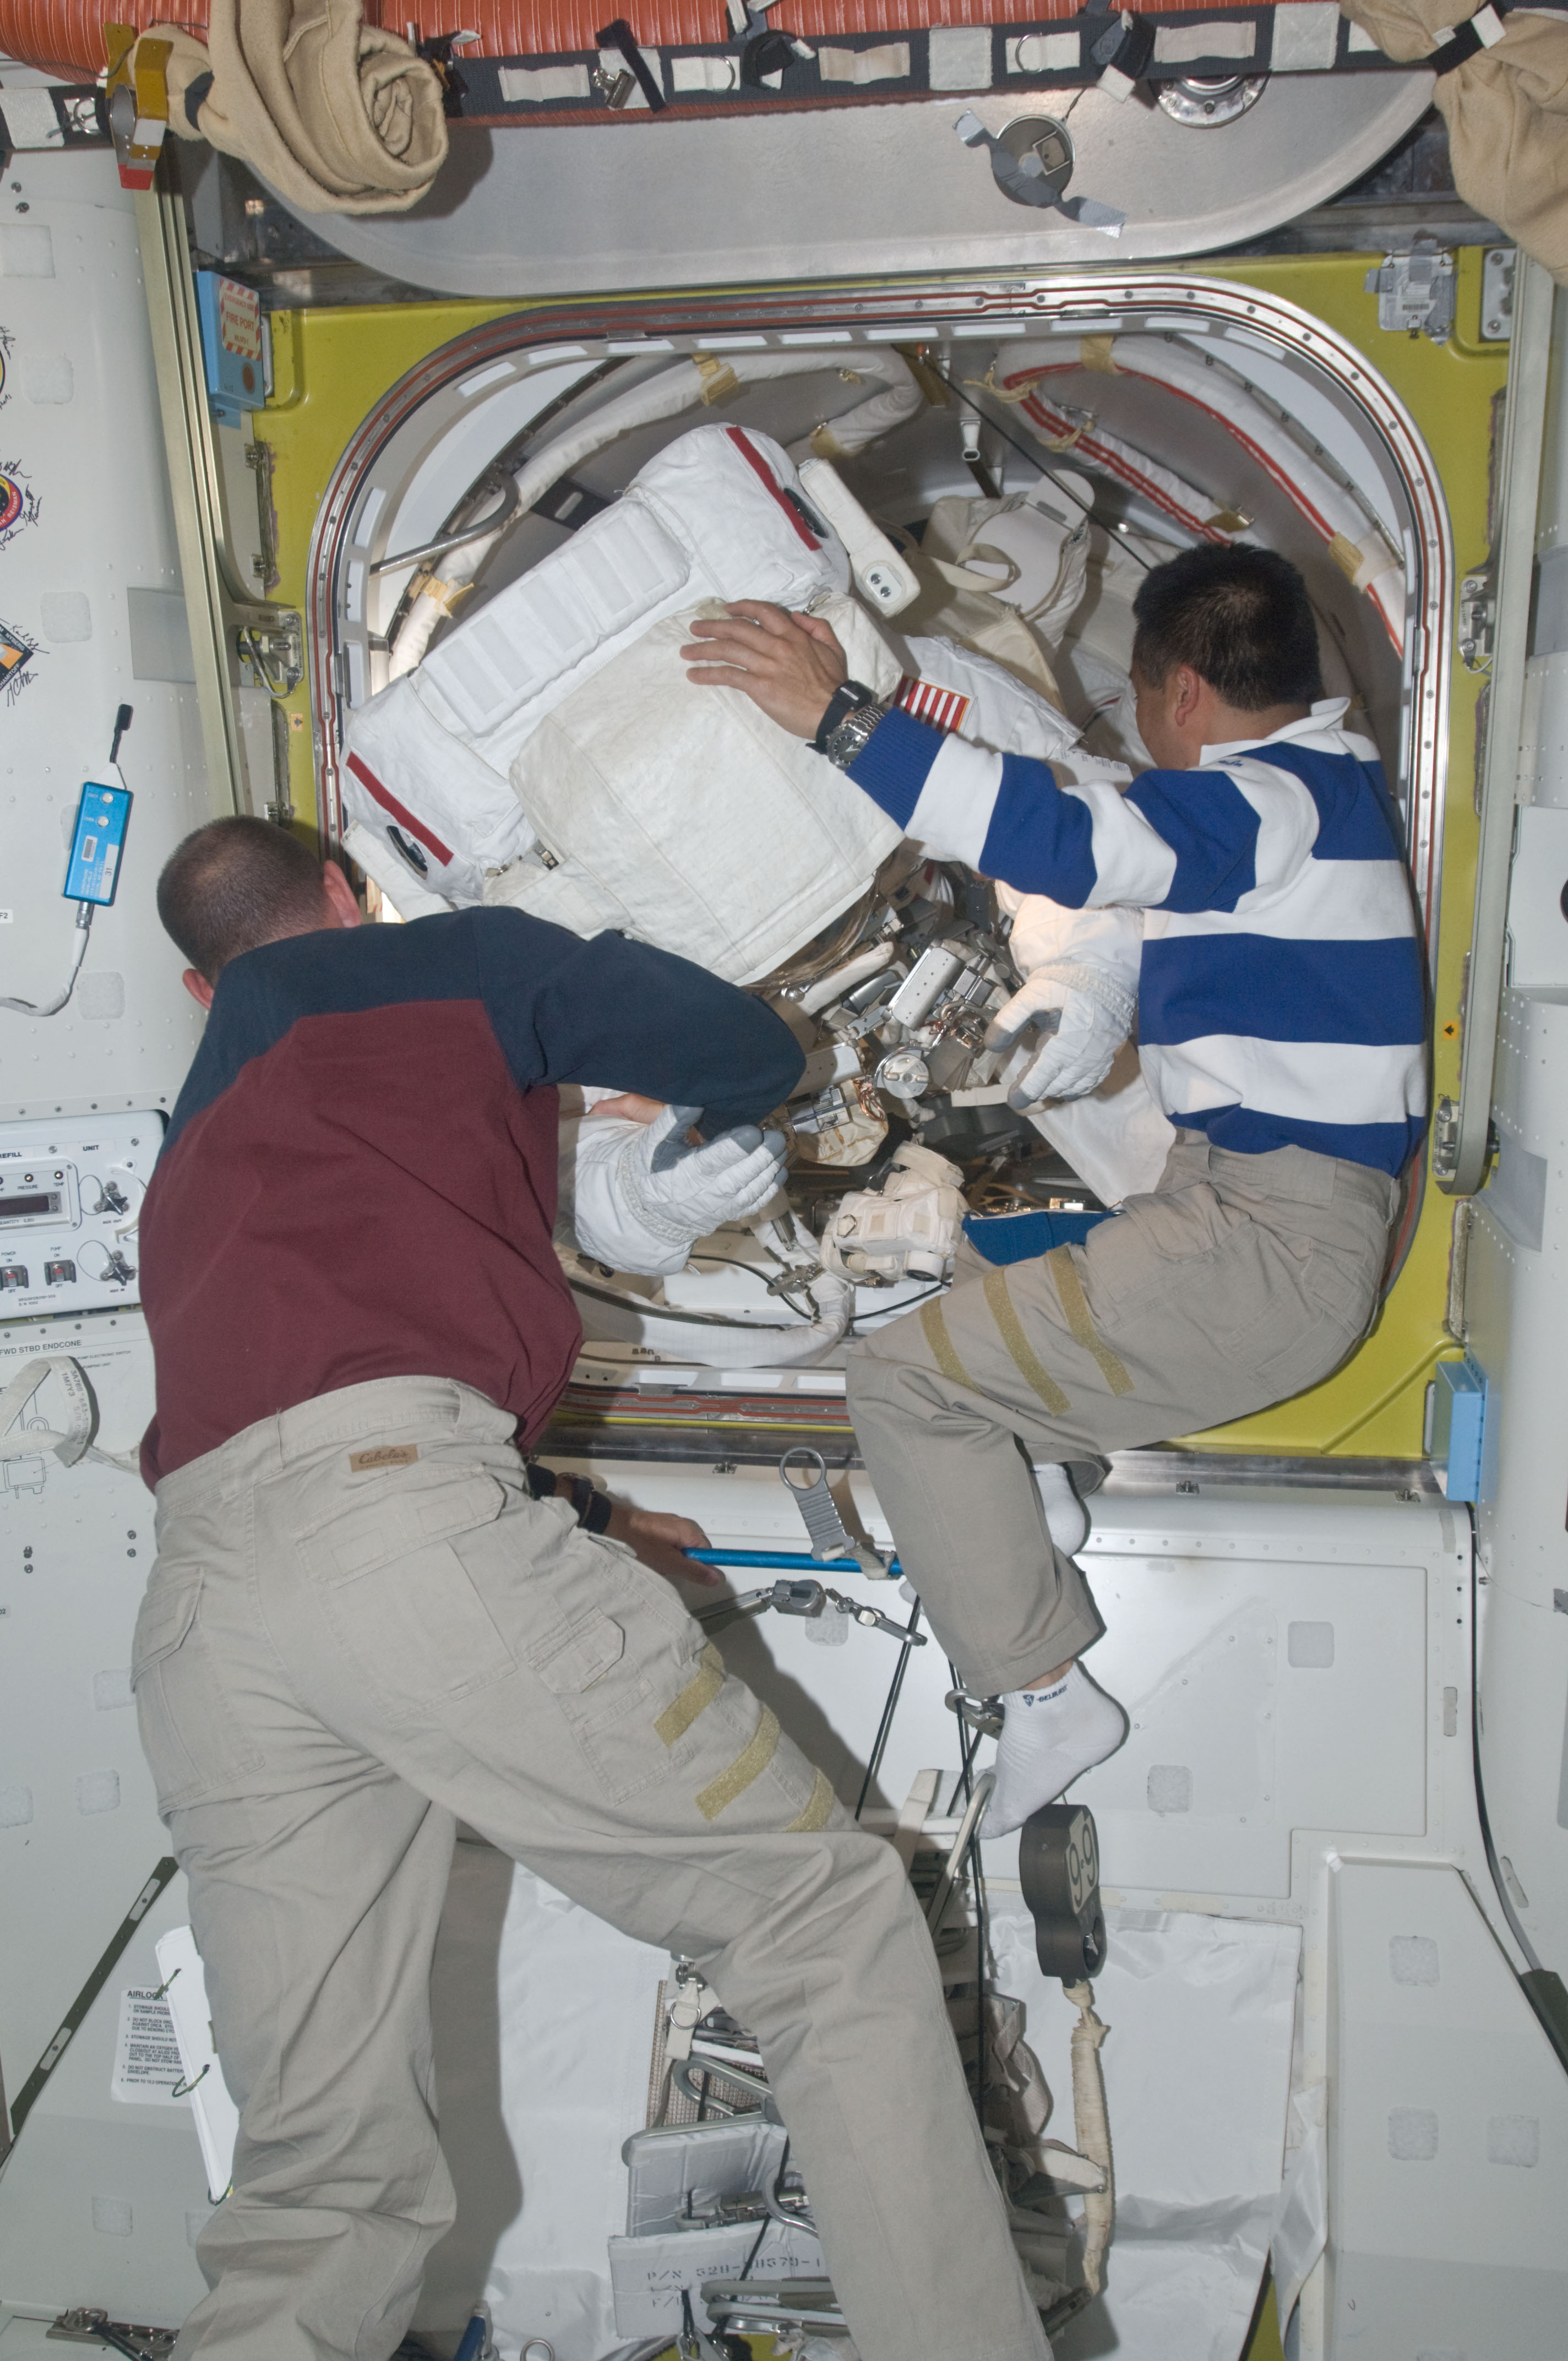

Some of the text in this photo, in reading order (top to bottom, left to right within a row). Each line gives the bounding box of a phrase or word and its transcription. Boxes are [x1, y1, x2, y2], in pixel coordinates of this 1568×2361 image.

[226, 311, 254, 331] FIRE PORT
[7, 491, 18, 518] REISMAN
[5, 632, 25, 651] NYBERG
[0, 662, 20, 688] HAMITOFF
[105, 867, 112, 876] 31
[19, 1345, 41, 1353] STBD
[42, 1340, 82, 1351] ENDCONE
